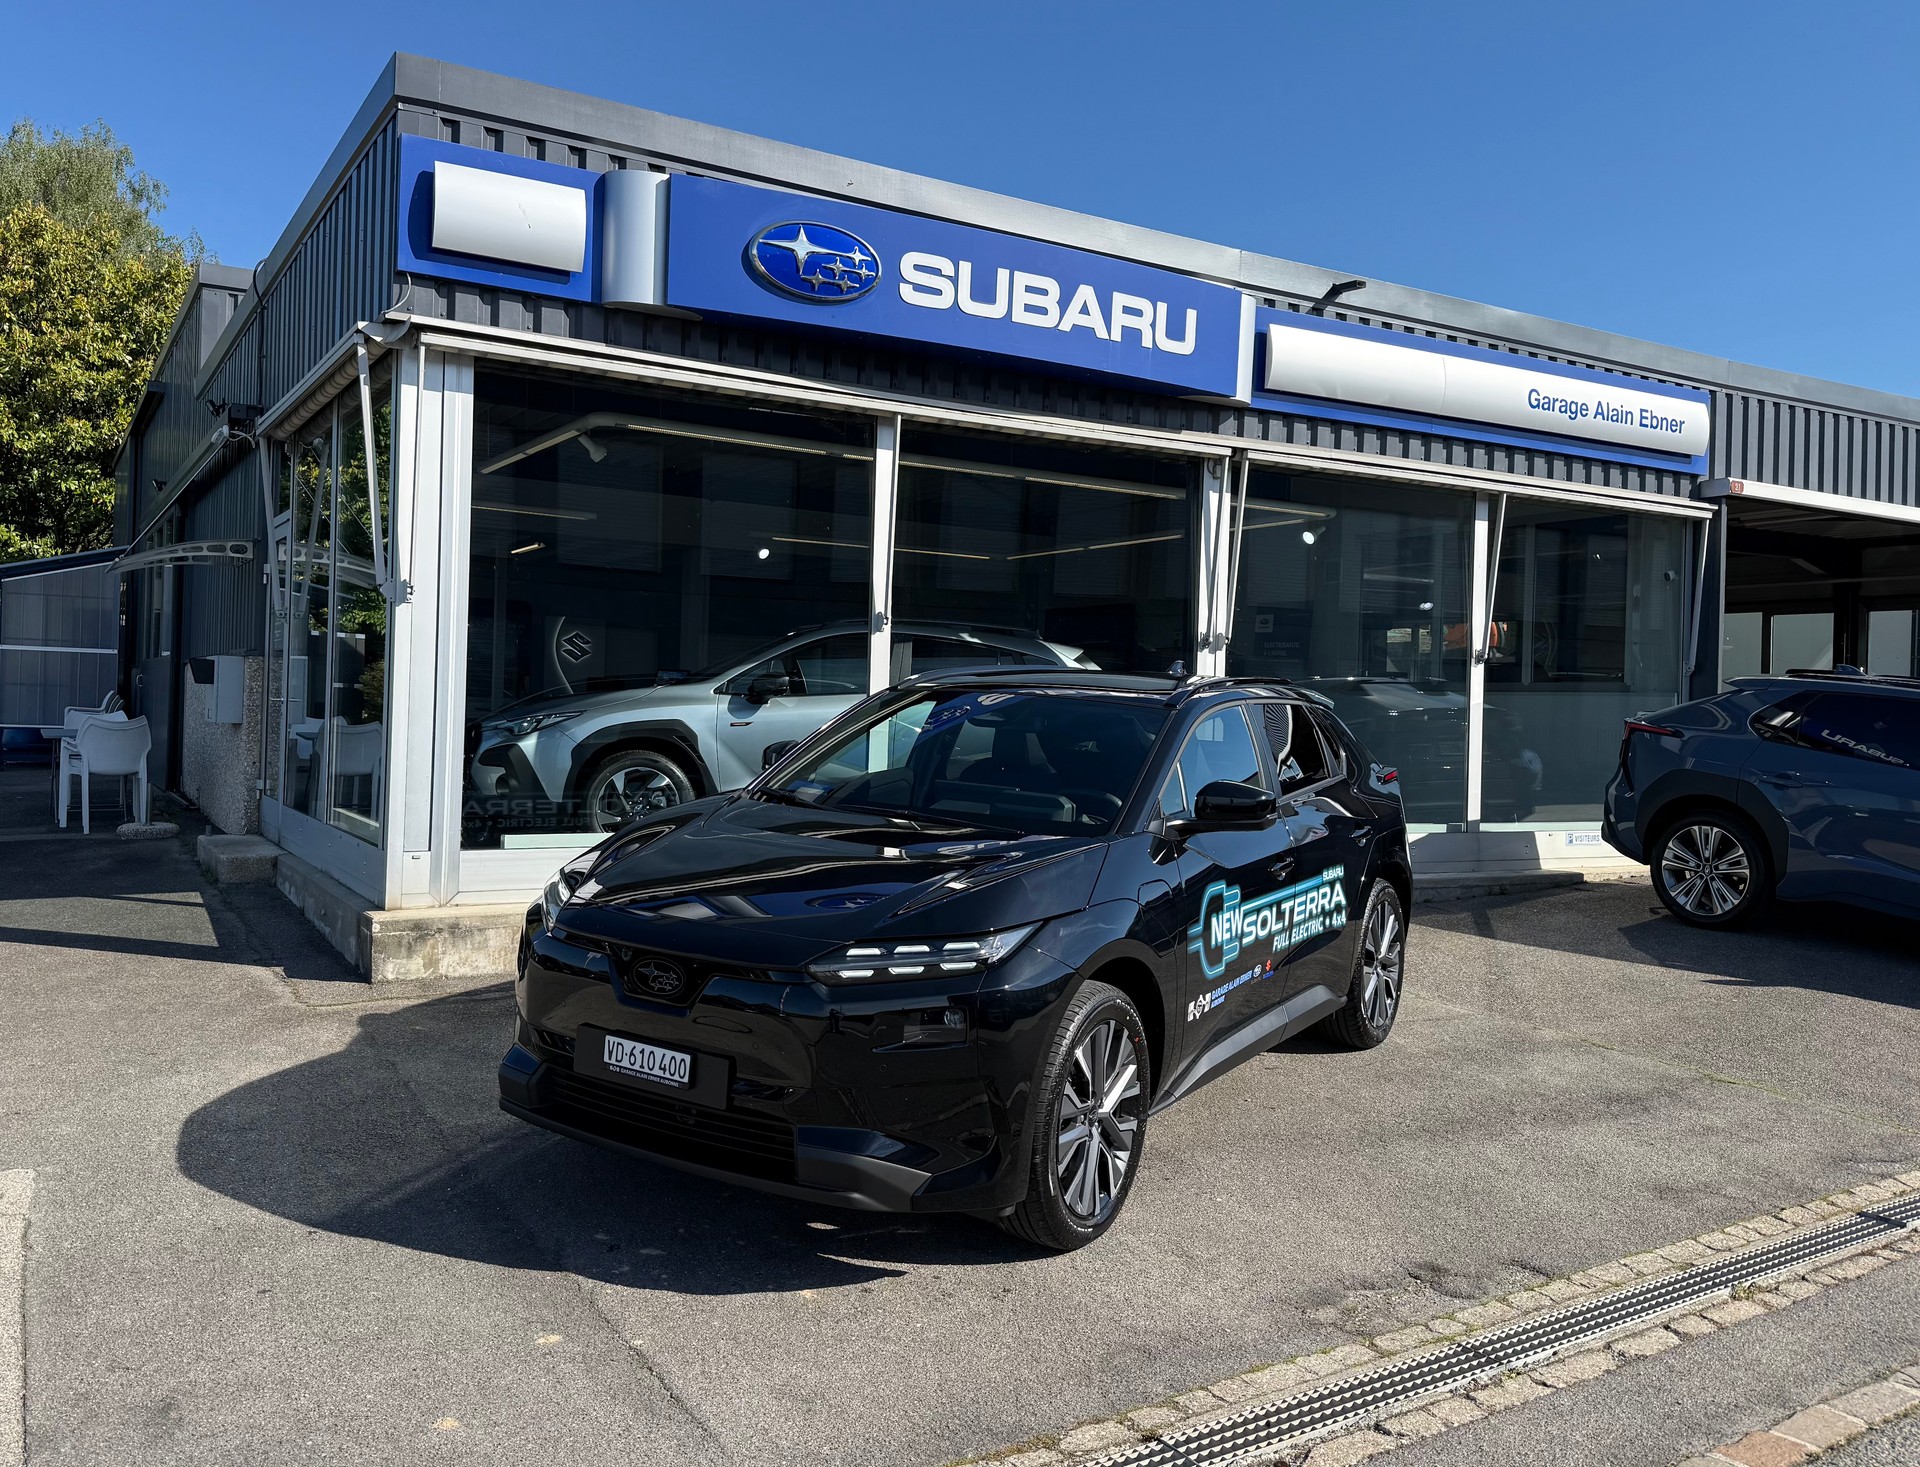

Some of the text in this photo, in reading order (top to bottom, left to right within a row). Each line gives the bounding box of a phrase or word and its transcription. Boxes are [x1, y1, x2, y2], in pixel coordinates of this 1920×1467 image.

[899, 251, 1198, 356] SUBARU
[1528, 388, 1685, 434] Garage Alain Ebner
[1575, 834, 1600, 842] VISITEURS
[1322, 865, 1344, 881] SUBARU
[1211, 883, 1347, 947] NEW SOLTERRA
[1272, 910, 1347, 952] FULL ELECTRIC 4x4
[620, 1067, 636, 1077] GARAGE
